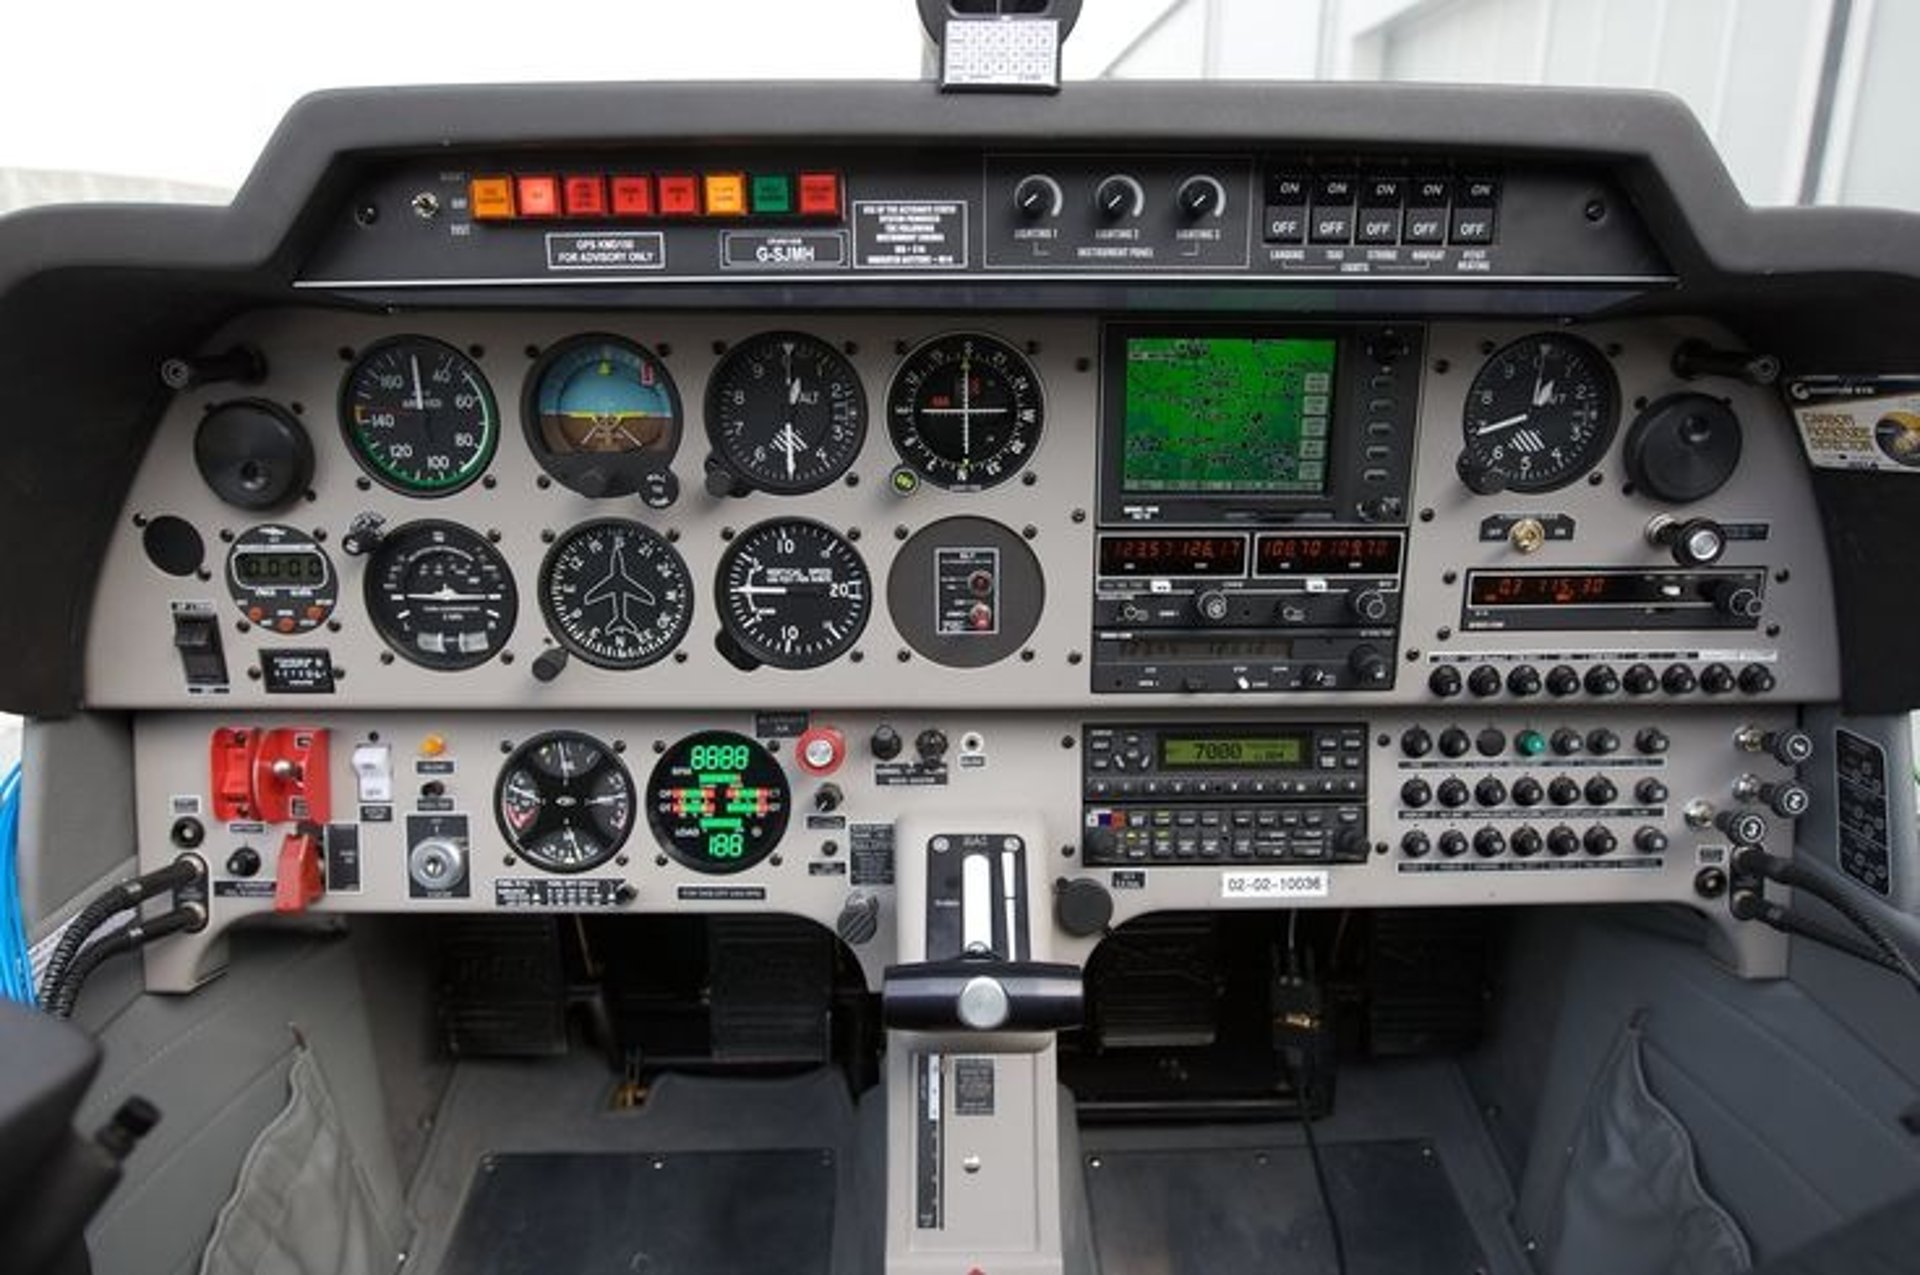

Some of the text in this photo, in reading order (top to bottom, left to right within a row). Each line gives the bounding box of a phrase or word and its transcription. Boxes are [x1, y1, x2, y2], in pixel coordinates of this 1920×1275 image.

[1280, 182, 1299, 193] ON
[1327, 182, 1347, 193] ON
[1376, 184, 1396, 195] ON
[1423, 184, 1443, 195] ON
[1471, 185, 1491, 195] ON
[1272, 222, 1297, 234] OFF
[1319, 221, 1345, 234] OFF
[1366, 223, 1391, 235] OFF
[1413, 222, 1437, 235] OFF
[1460, 223, 1484, 235] OFF
[756, 246, 815, 262] G-SJMH
[831, 383, 841, 399] 2
[456, 396, 473, 408] 60
[371, 415, 394, 427] 140
[833, 425, 844, 441] 3
[455, 434, 473, 447] 80
[390, 445, 413, 458] 120
[754, 445, 766, 461] 6
[1492, 445, 1504, 460] 6
[427, 456, 449, 469] 100
[1520, 455, 1532, 470] 5
[776, 538, 795, 554] 10
[829, 583, 849, 598] 20
[781, 625, 799, 640] 10
[690, 745, 749, 770] 8888
[1193, 742, 1243, 760] 7000
[1747, 823, 1758, 836] 3
[709, 833, 743, 857] 188
[1228, 877, 1322, 892] 02-02-10036
